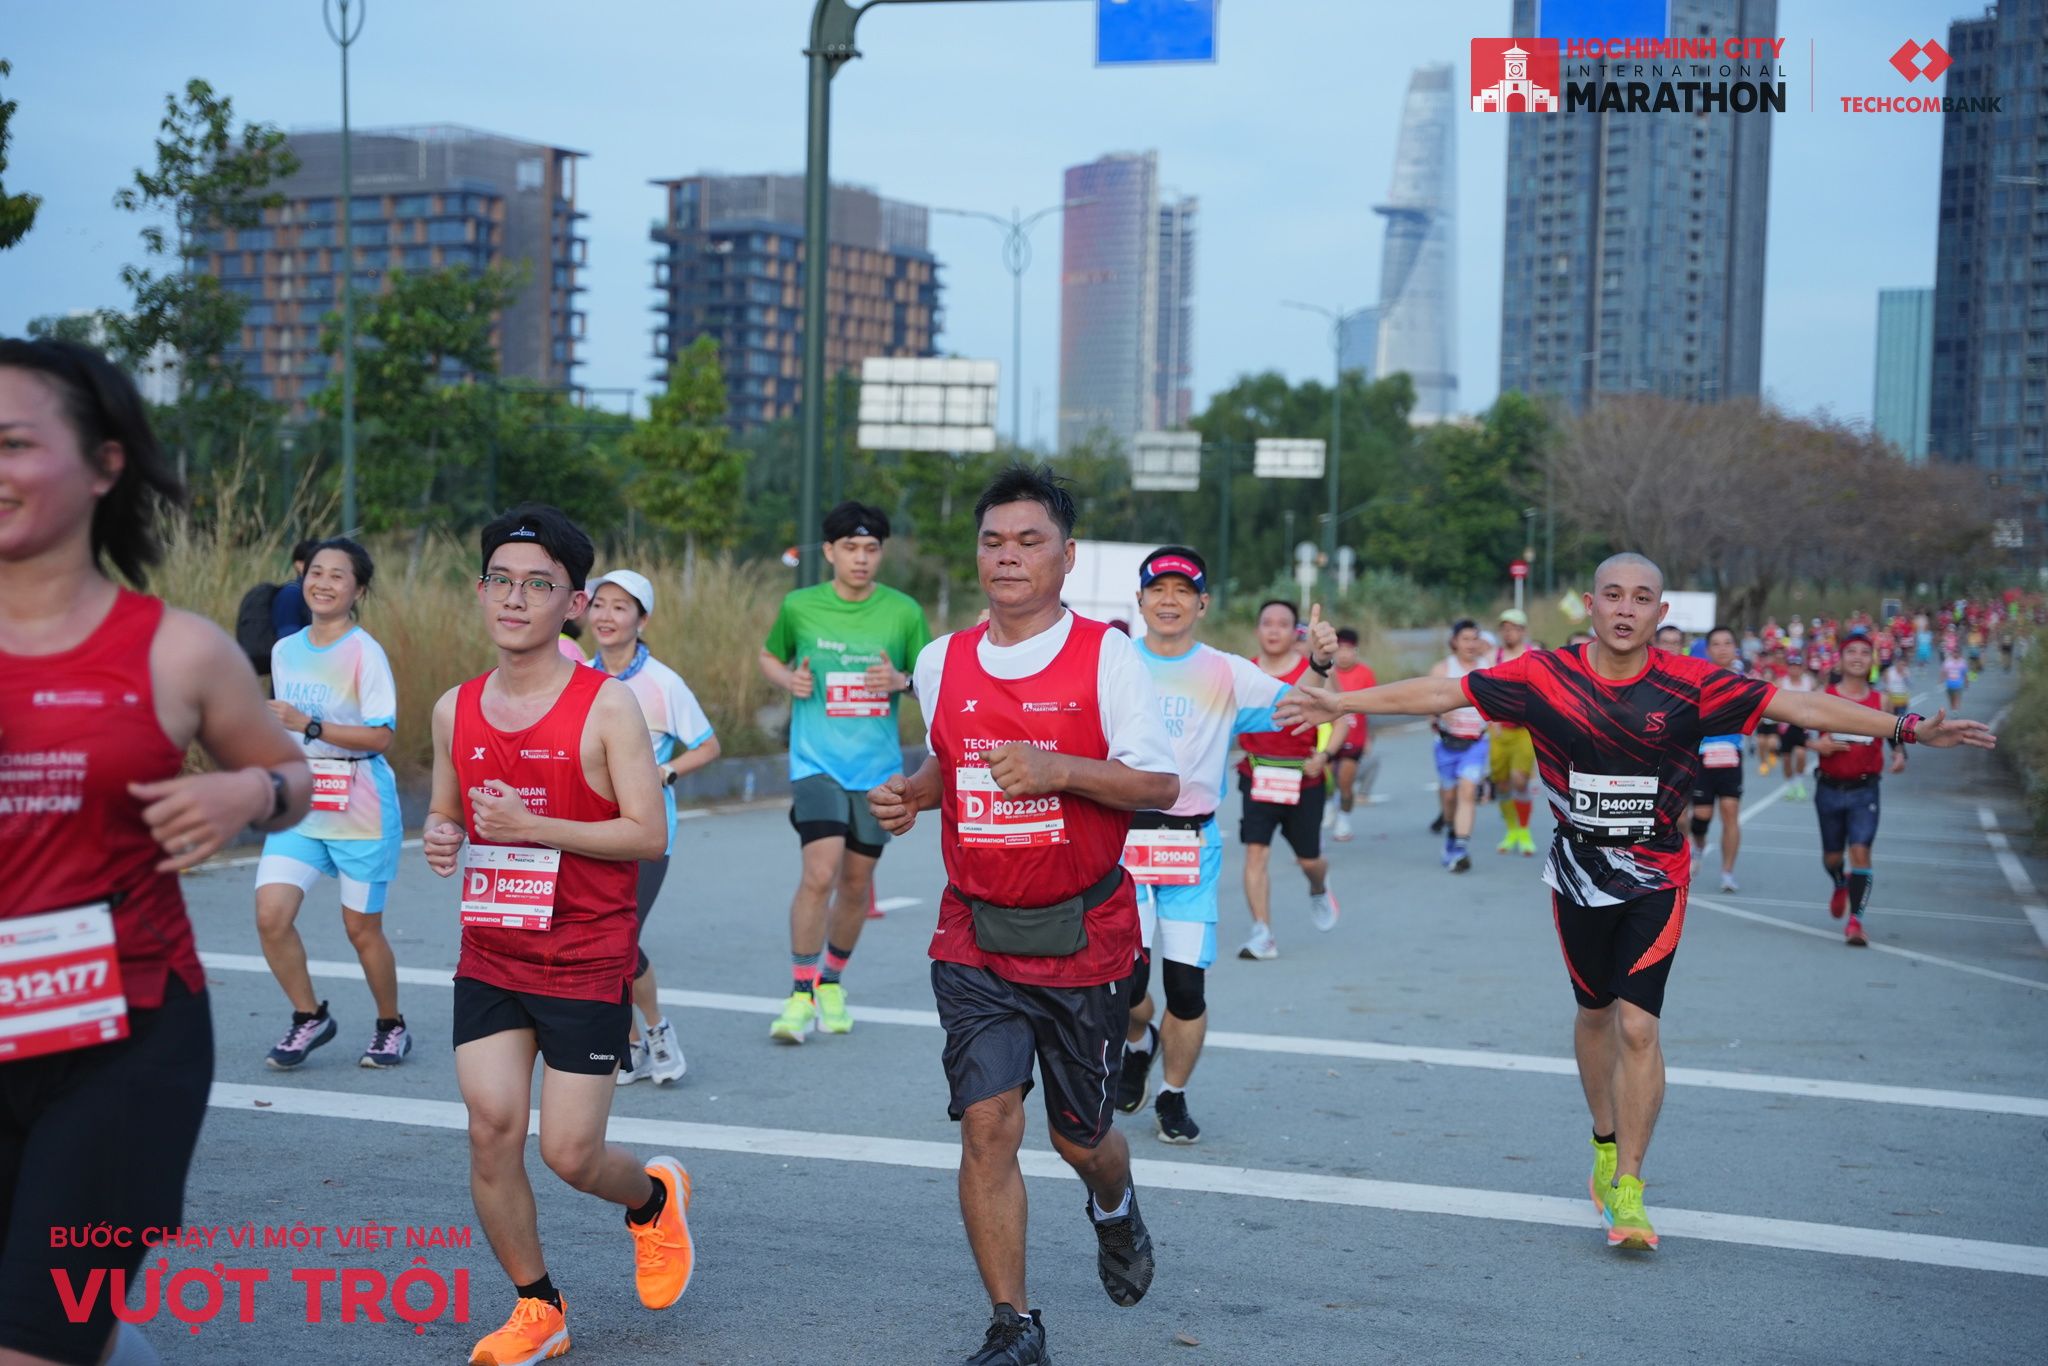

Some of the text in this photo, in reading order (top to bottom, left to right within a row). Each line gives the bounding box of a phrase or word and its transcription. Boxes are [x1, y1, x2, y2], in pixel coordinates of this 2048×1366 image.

[966, 796, 1060, 818] D 802203
[1575, 791, 1654, 810] D 940075
[1153, 851, 1196, 863] 201040
[470, 872, 554, 895] D 842208
[0, 959, 108, 1004] 312177
